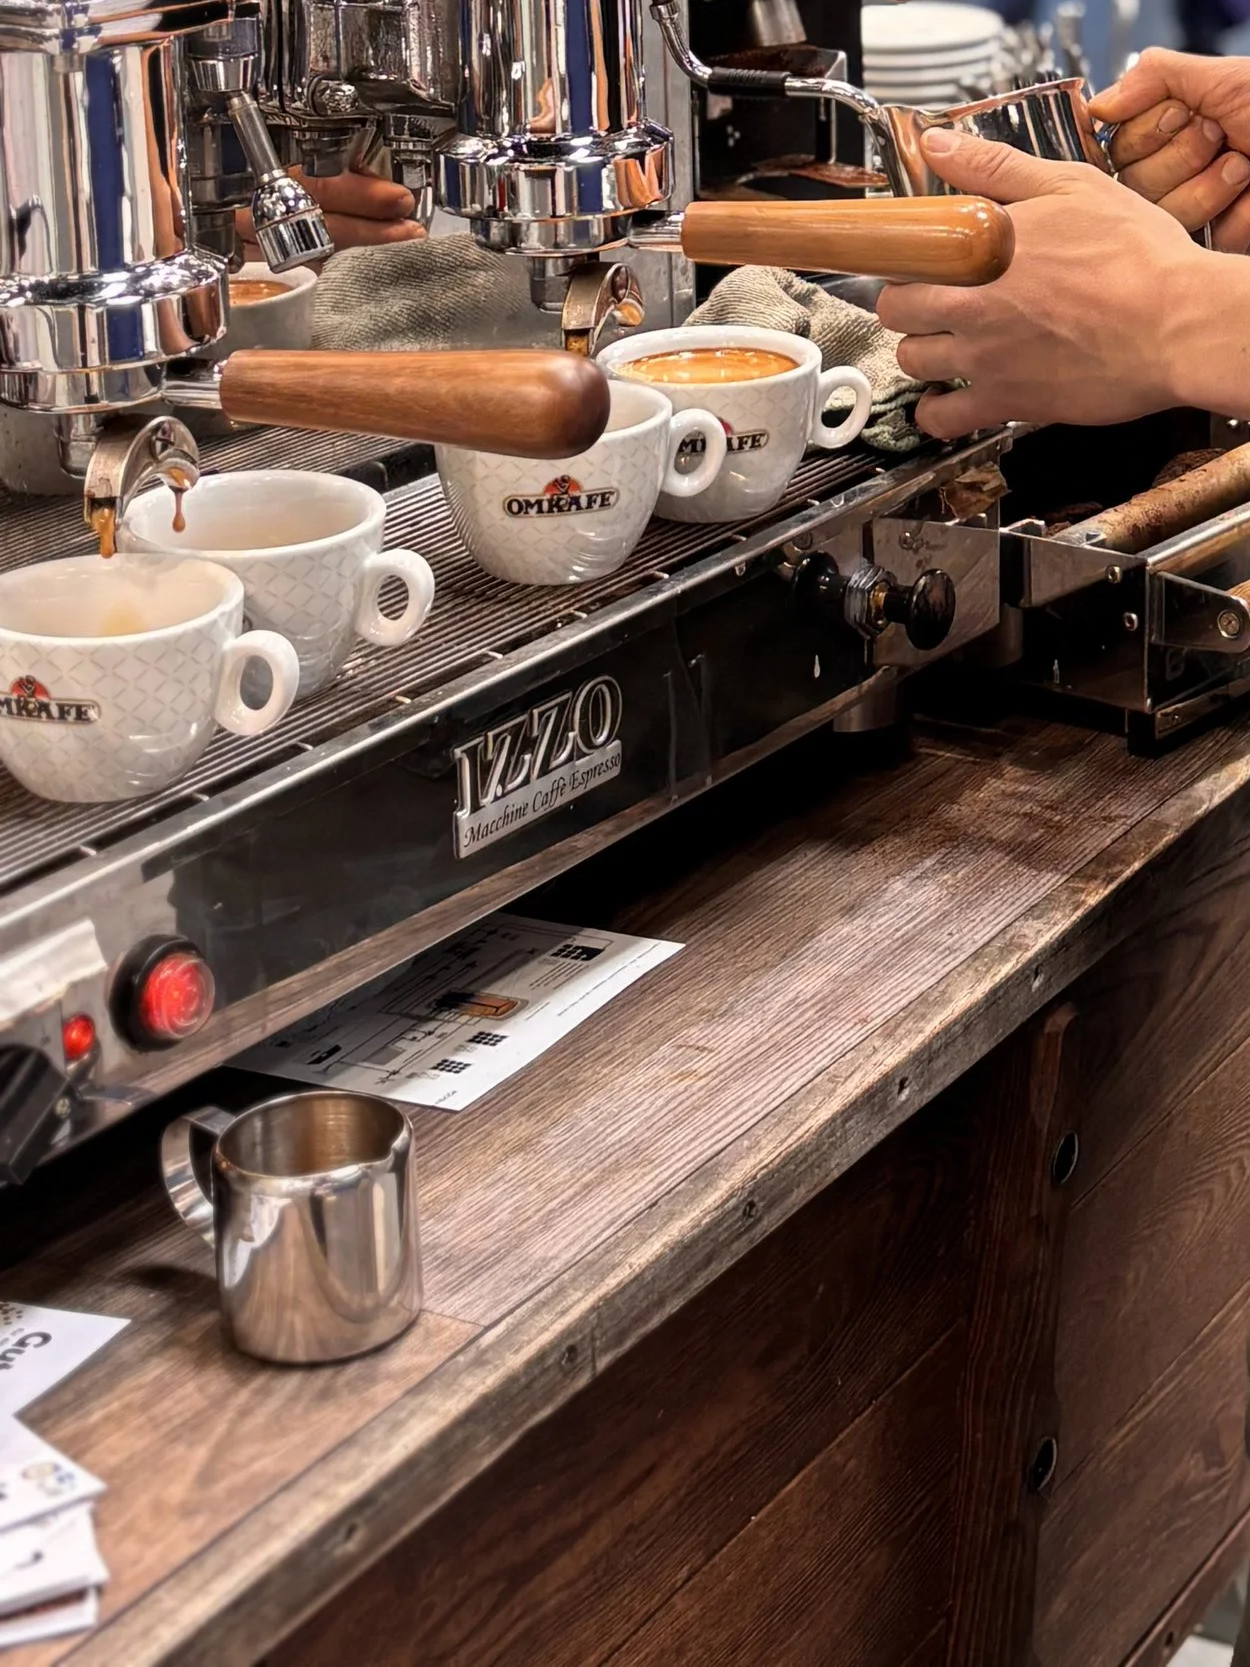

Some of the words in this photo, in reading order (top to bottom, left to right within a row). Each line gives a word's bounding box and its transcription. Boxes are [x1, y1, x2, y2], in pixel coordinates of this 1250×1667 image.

[506, 490, 615, 515] OMKAFE
[453, 675, 623, 819] IZZO
[463, 801, 529, 848] Macchine
[568, 752, 621, 792] Espresso
